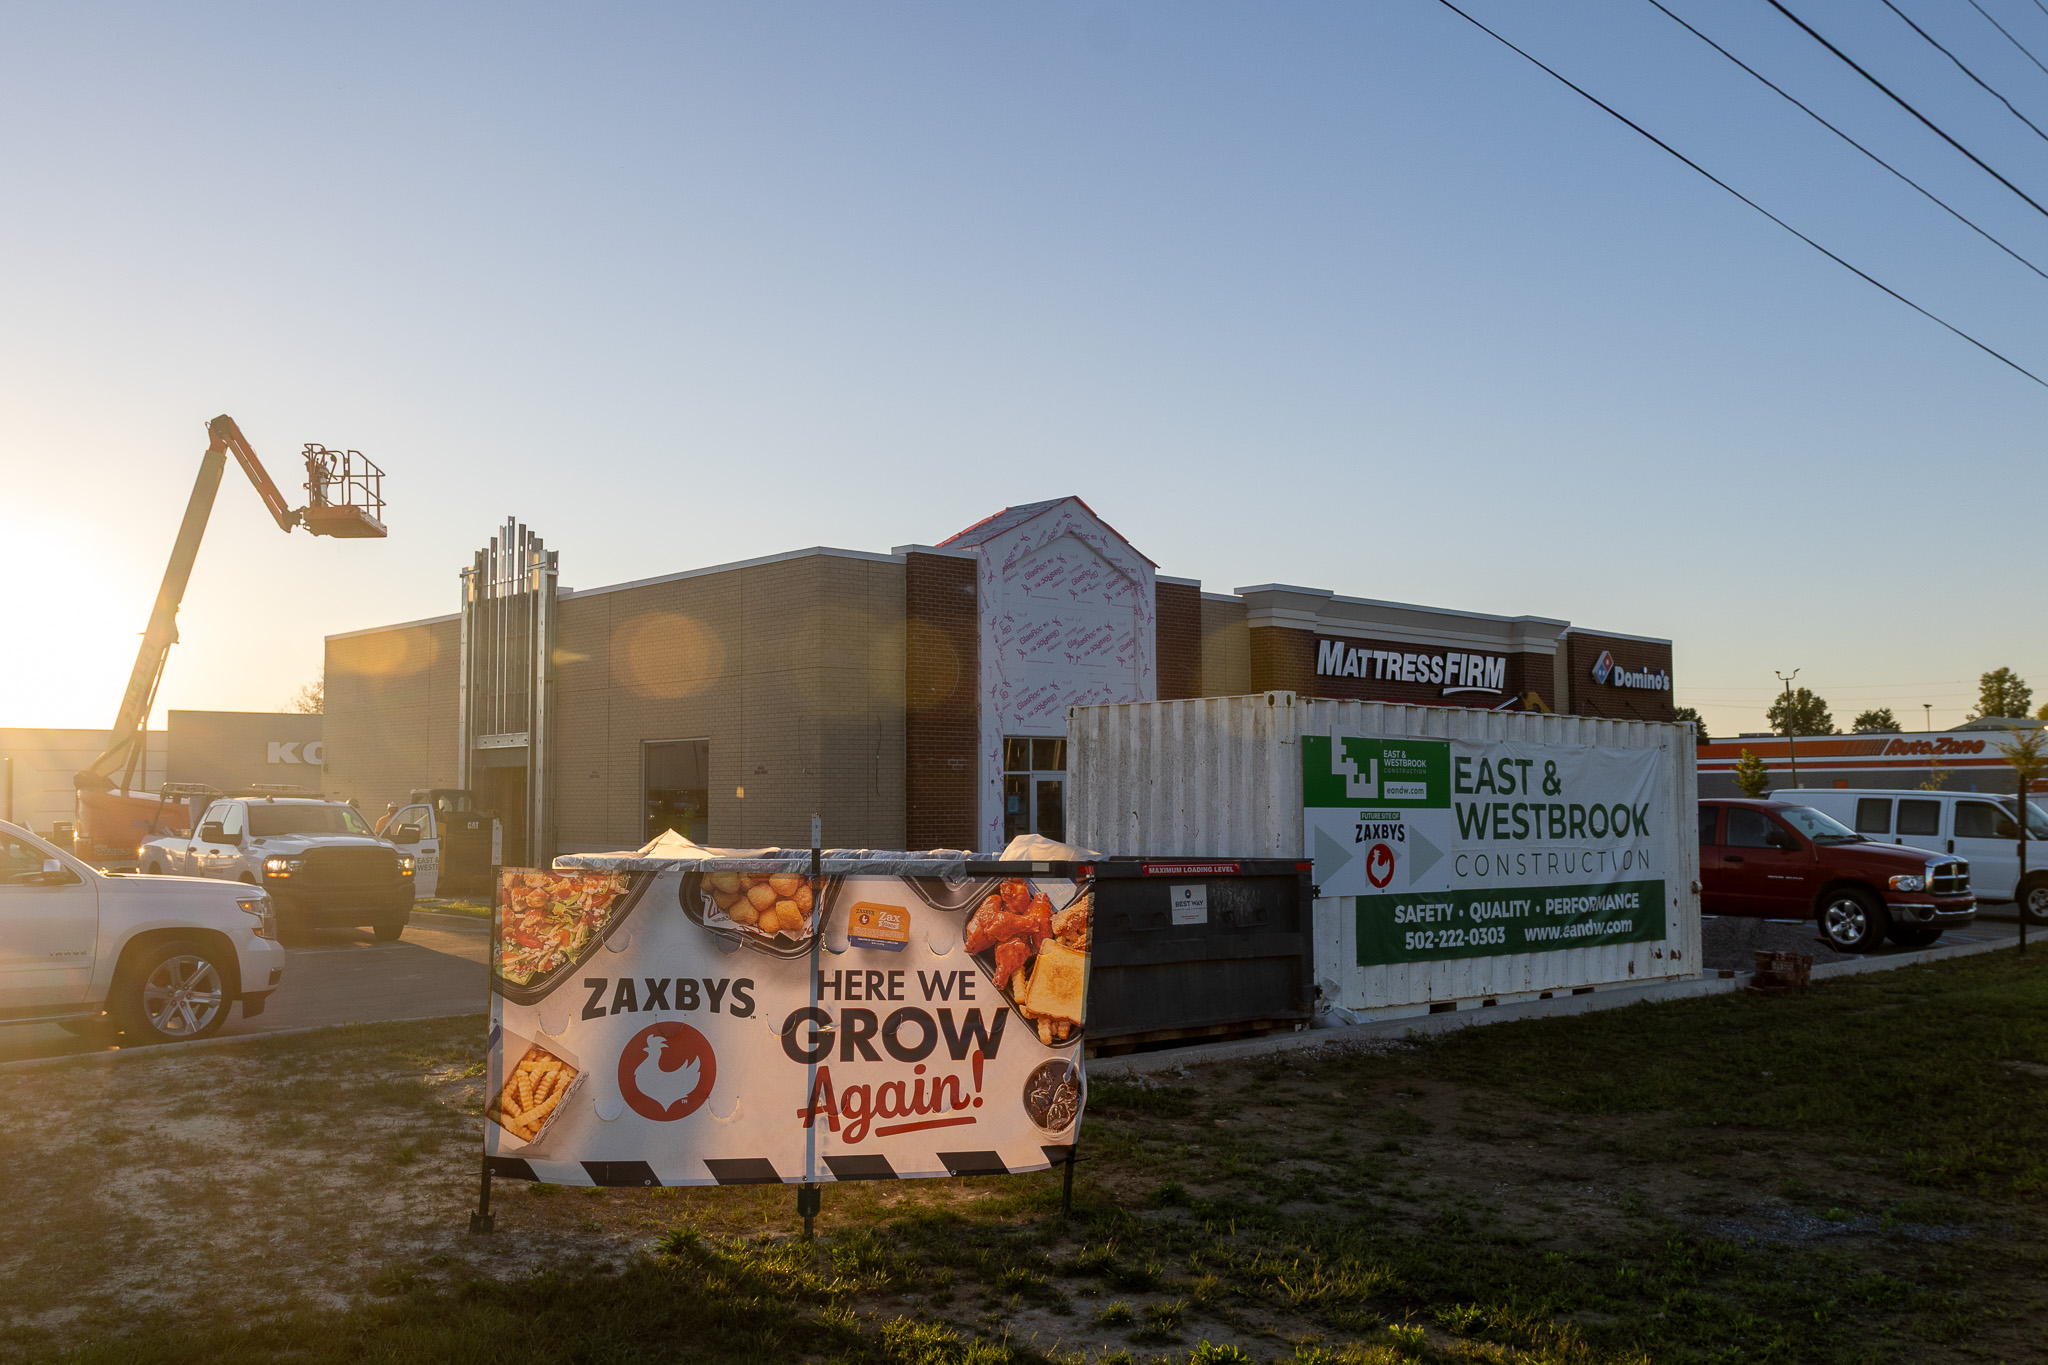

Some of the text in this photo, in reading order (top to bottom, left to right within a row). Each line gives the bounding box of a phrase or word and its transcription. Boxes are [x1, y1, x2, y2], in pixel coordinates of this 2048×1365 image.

[1614, 666, 1670, 691] Domino's
[1383, 750, 1407, 759] EAST &
[1884, 737, 1986, 756] AutoZone
[1383, 758, 1427, 768] WESTBROOK
[1383, 767, 1427, 775] CONSTRUCTION
[1454, 756, 1562, 796] EAST &
[1386, 785, 1425, 795] eandw.com
[467, 821, 480, 830] CAT
[1355, 823, 1405, 844] ZAXBYS
[1454, 802, 1650, 841] WESTBROOK
[1183, 866, 1213, 874] LOADING
[1455, 849, 1650, 877] CONSTRUCTION
[878, 911, 901, 923] Zax
[1394, 892, 1640, 924] SAFETY QUALITY PERFORMANCE
[1405, 917, 1633, 951] 502-222-0303 www.eandw.com
[817, 969, 976, 1002] HERE WE
[581, 977, 756, 1021] ZAXBYS
[781, 1006, 1010, 1064] GROW
[796, 1049, 985, 1145] Again!
